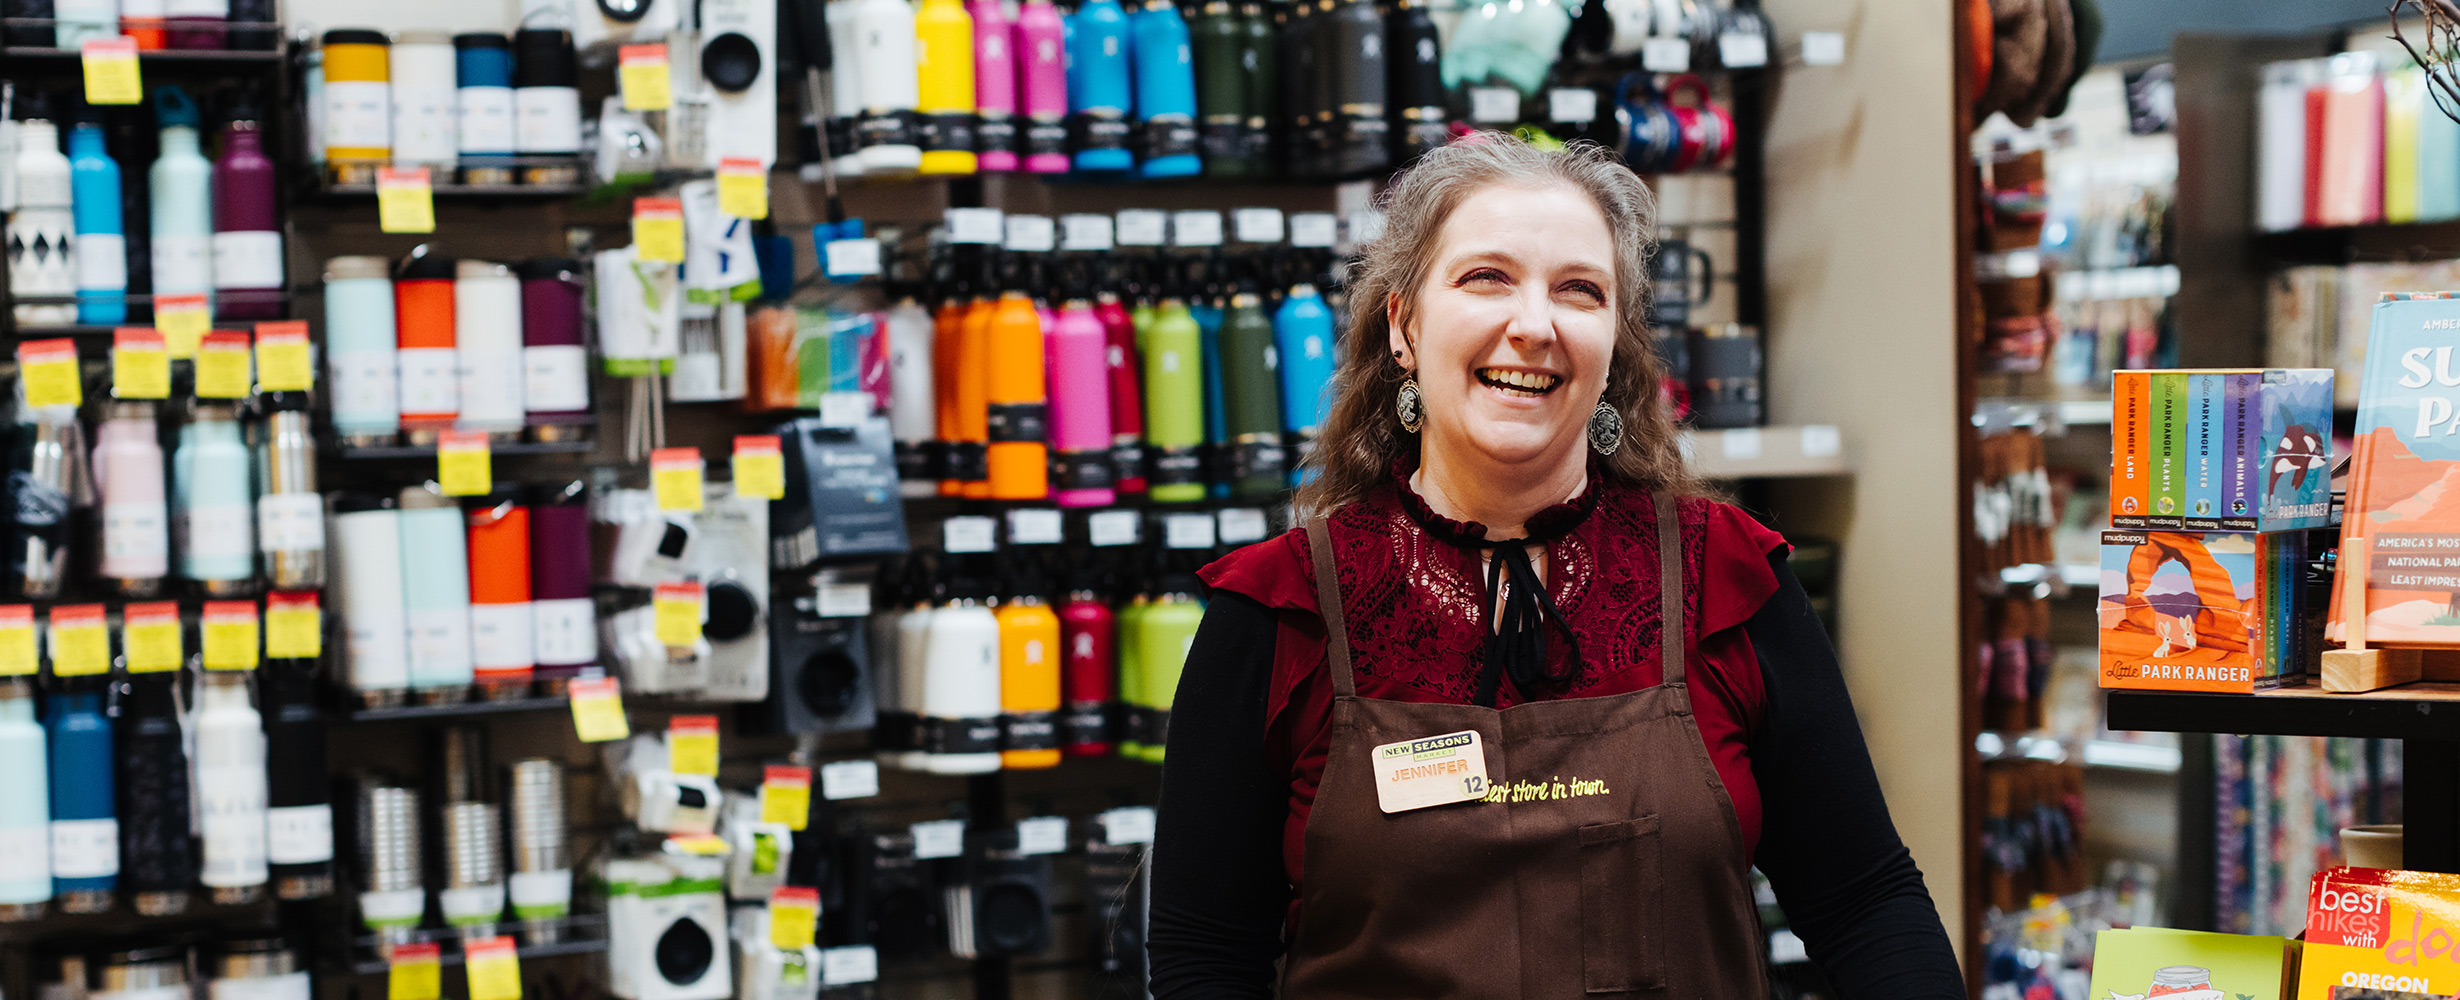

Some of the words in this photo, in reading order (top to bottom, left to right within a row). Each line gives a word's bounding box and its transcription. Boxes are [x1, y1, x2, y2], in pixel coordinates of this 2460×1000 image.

[2164, 400, 2172, 421] PARK
[2163, 423, 2171, 457] RANGER
[2201, 422, 2209, 456] RANGER
[2237, 422, 2245, 456] RANGER
[2126, 456, 2134, 479] LAND
[2162, 458, 2170, 492] PLANTS
[2200, 458, 2208, 488] WATER
[2236, 457, 2245, 497] ANIMALS
[2279, 505, 2298, 519] PARK
[2300, 502, 2328, 517] RANGER
[2104, 535, 2146, 544] mudpuppy
[2378, 538, 2434, 548] AMERICA'S
[2388, 557, 2442, 567] NATIONAL
[2390, 575, 2423, 585] LEAST
[2106, 660, 2139, 680] Little
[2142, 664, 2182, 679] PARK
[2185, 666, 2249, 682] RANGER
[1385, 746, 1410, 756] NEW
[1414, 735, 1470, 752] SEASONS
[1416, 749, 1453, 760] MARKET
[1391, 759, 1469, 782] JENNIFER
[1464, 776, 1483, 794] 12
[1512, 779, 1549, 802] store
[1552, 776, 1568, 800] in
[1570, 776, 1610, 798] town.
[2320, 875, 2386, 914] best
[2308, 898, 2380, 935] hikes
[2342, 930, 2376, 948] with
[2341, 971, 2429, 994] OREGON
